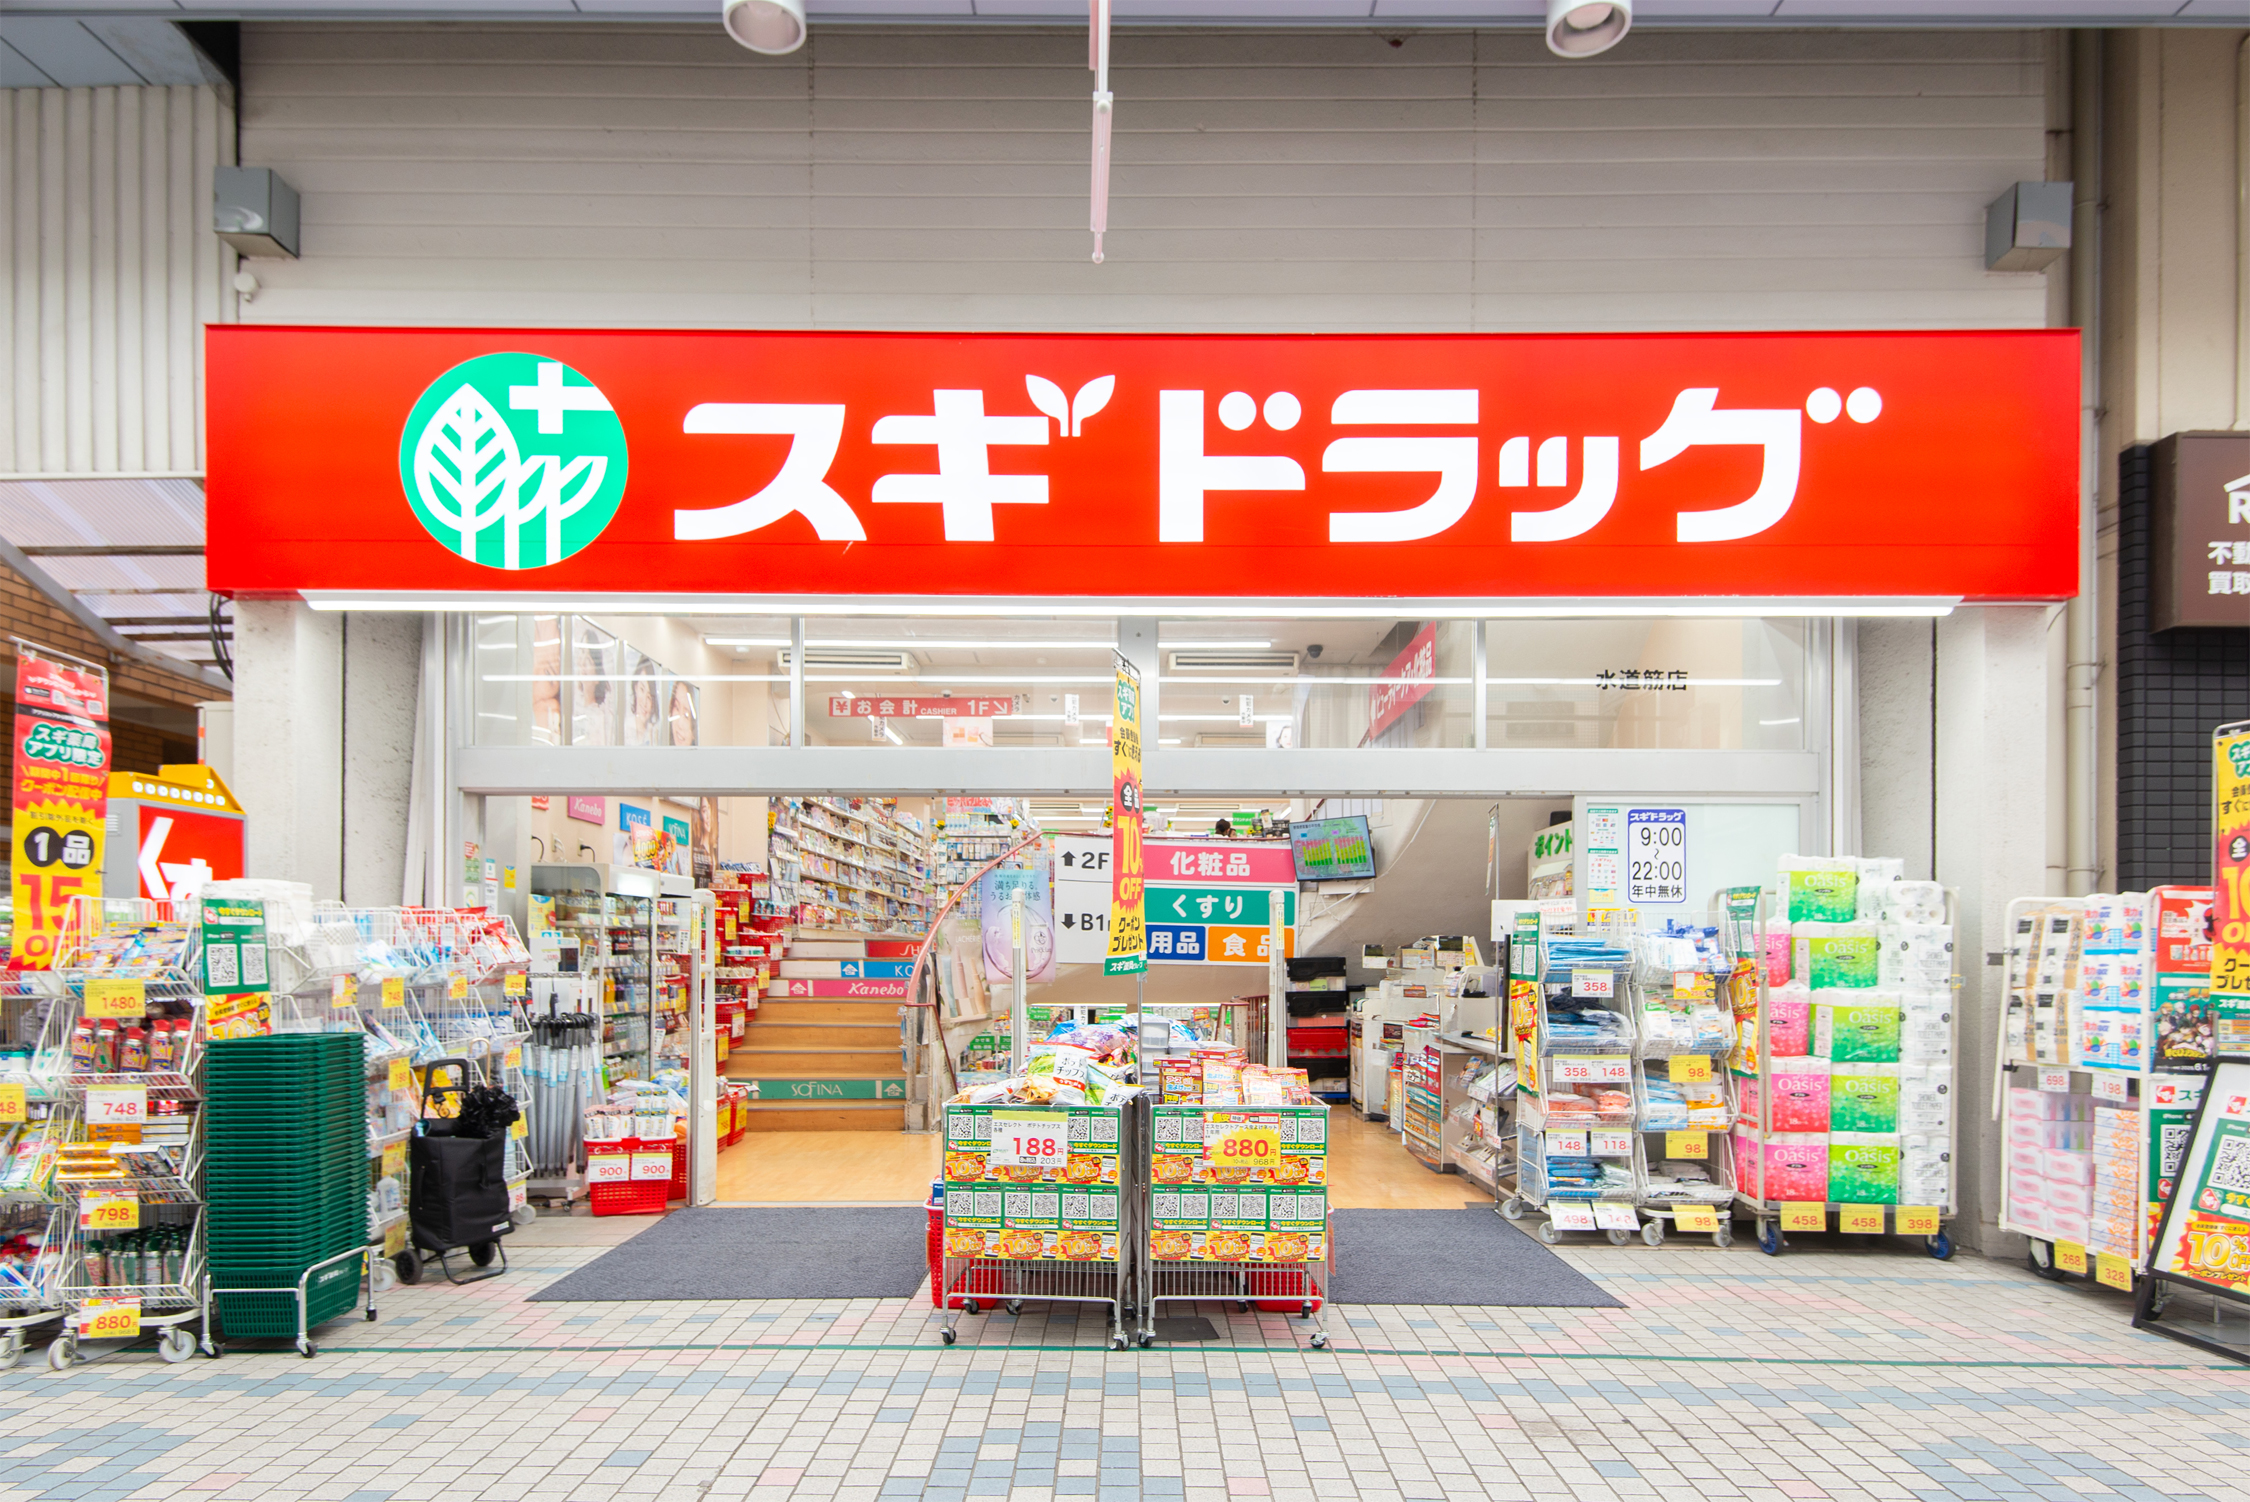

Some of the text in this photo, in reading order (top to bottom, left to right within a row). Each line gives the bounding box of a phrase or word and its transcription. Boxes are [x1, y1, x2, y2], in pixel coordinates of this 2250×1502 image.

[674, 374, 1882, 544] スギドラッグ
[1596, 669, 1688, 690] 水道筋店
[857, 700, 918, 715] お会計
[967, 701, 989, 715] 1F
[574, 797, 602, 817] Kanebo
[1630, 811, 1684, 822] スギドラッグ
[1535, 829, 1572, 859] ポイント
[1640, 827, 1682, 846] 9:00
[34, 831, 91, 865] 1品
[1081, 851, 1250, 876] 2F 化粧品
[1632, 861, 1682, 881] 22:00
[1119, 876, 1142, 901] OFF
[1804, 874, 1847, 888] Oasis
[1631, 885, 1683, 898] 年中無休
[1172, 894, 1243, 919] くすり
[1081, 913, 1110, 932] B1
[1149, 931, 1200, 955] 用品
[1824, 941, 1867, 954] Oasis
[848, 982, 904, 996] Kanebo
[1849, 1010, 1892, 1024] Oasis
[1057, 1066, 1086, 1080] チップス
[791, 1081, 843, 1098] SOFINA
[1778, 1078, 1822, 1091] Oasis
[1845, 1080, 1890, 1093] Oasis
[1774, 1149, 1819, 1163] Oasis
[1845, 1150, 1891, 1163] Oasis
